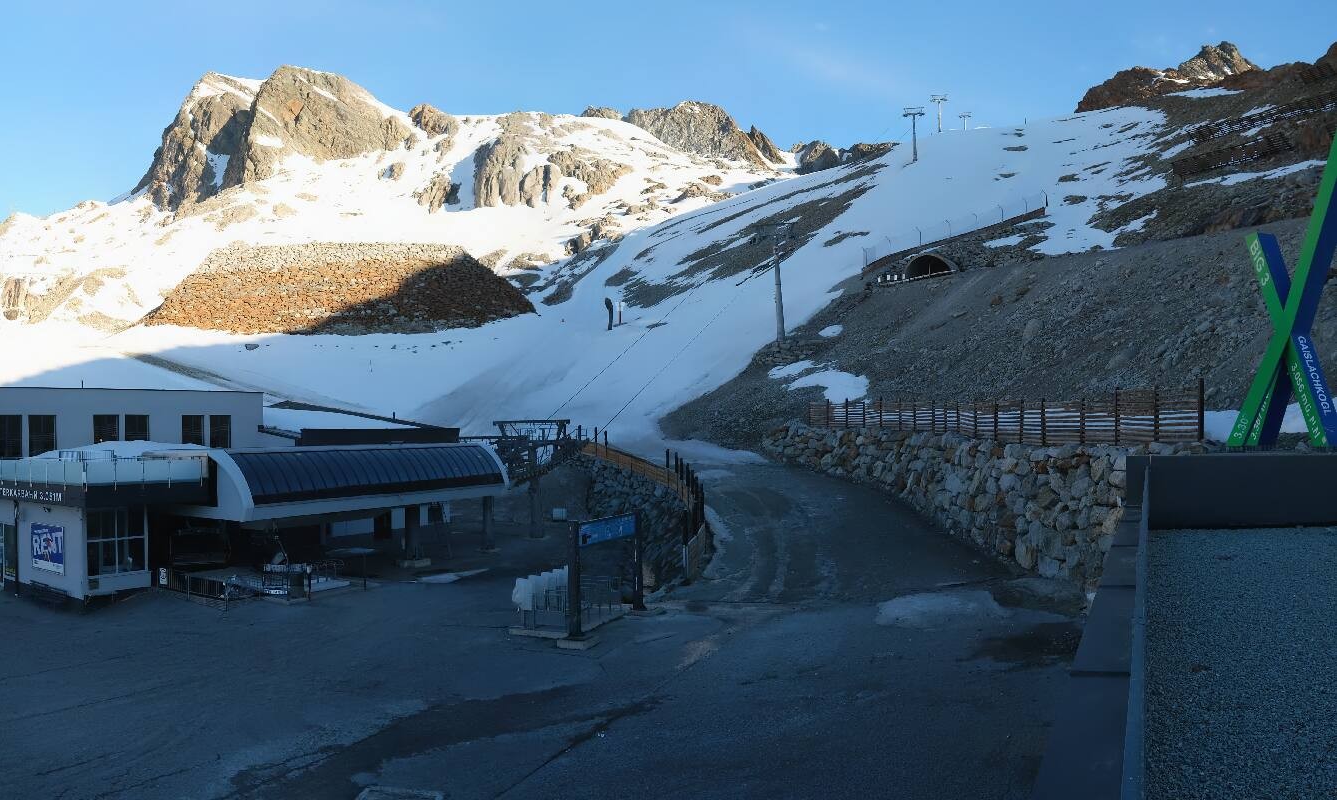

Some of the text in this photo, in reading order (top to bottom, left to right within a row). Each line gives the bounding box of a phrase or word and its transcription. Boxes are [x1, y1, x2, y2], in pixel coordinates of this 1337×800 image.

[1249, 239, 1270, 287] BIG 3
[1297, 335, 1332, 417] GAISLACHKOGL
[32, 531, 63, 556] RENT
